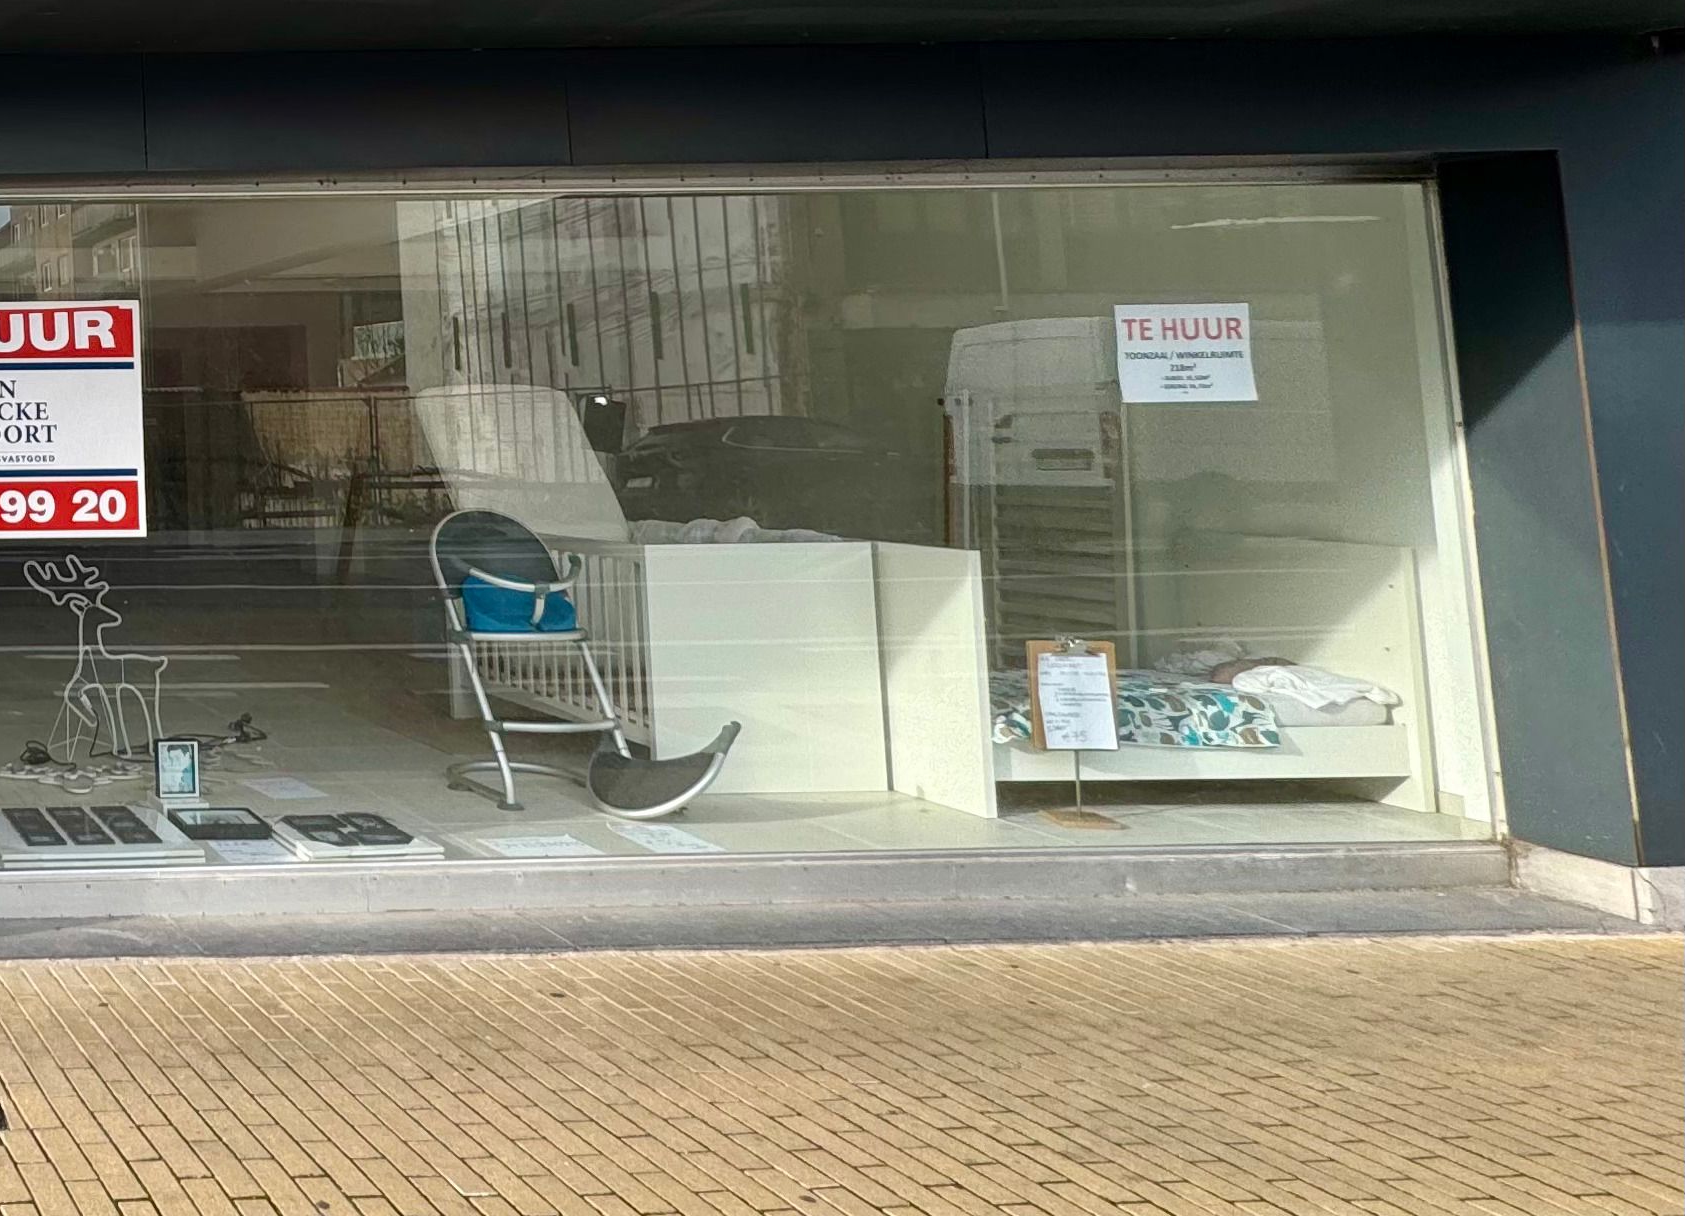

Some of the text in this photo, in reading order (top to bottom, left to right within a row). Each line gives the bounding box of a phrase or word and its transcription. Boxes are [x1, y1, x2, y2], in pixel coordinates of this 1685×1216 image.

[1121, 317, 1244, 341] TE HUUR
[1176, 350, 1244, 359] WINKELRUIMTE
[0, 489, 57, 523] 99
[71, 488, 128, 523] 20
